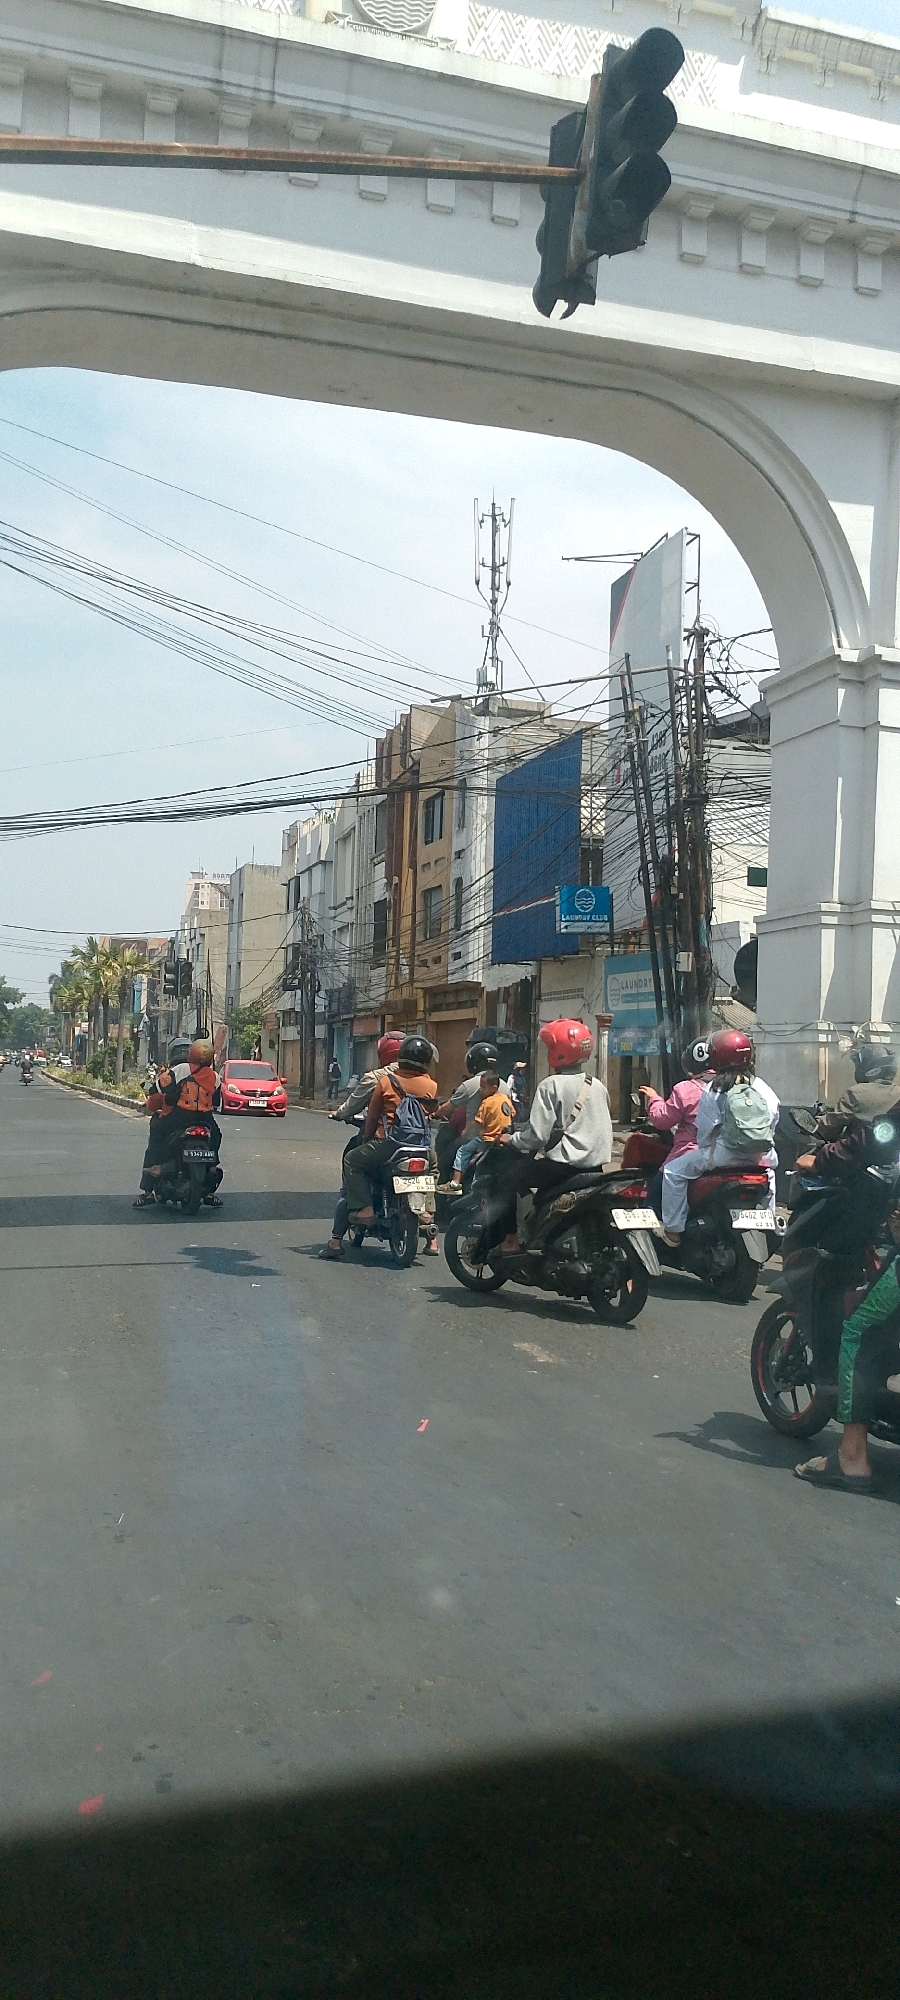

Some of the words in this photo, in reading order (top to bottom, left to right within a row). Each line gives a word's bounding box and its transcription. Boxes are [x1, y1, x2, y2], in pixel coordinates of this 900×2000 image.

[621, 977, 653, 990] LAUNDRY
[697, 1046, 704, 1058] 8
[732, 1210, 737, 1219] D
